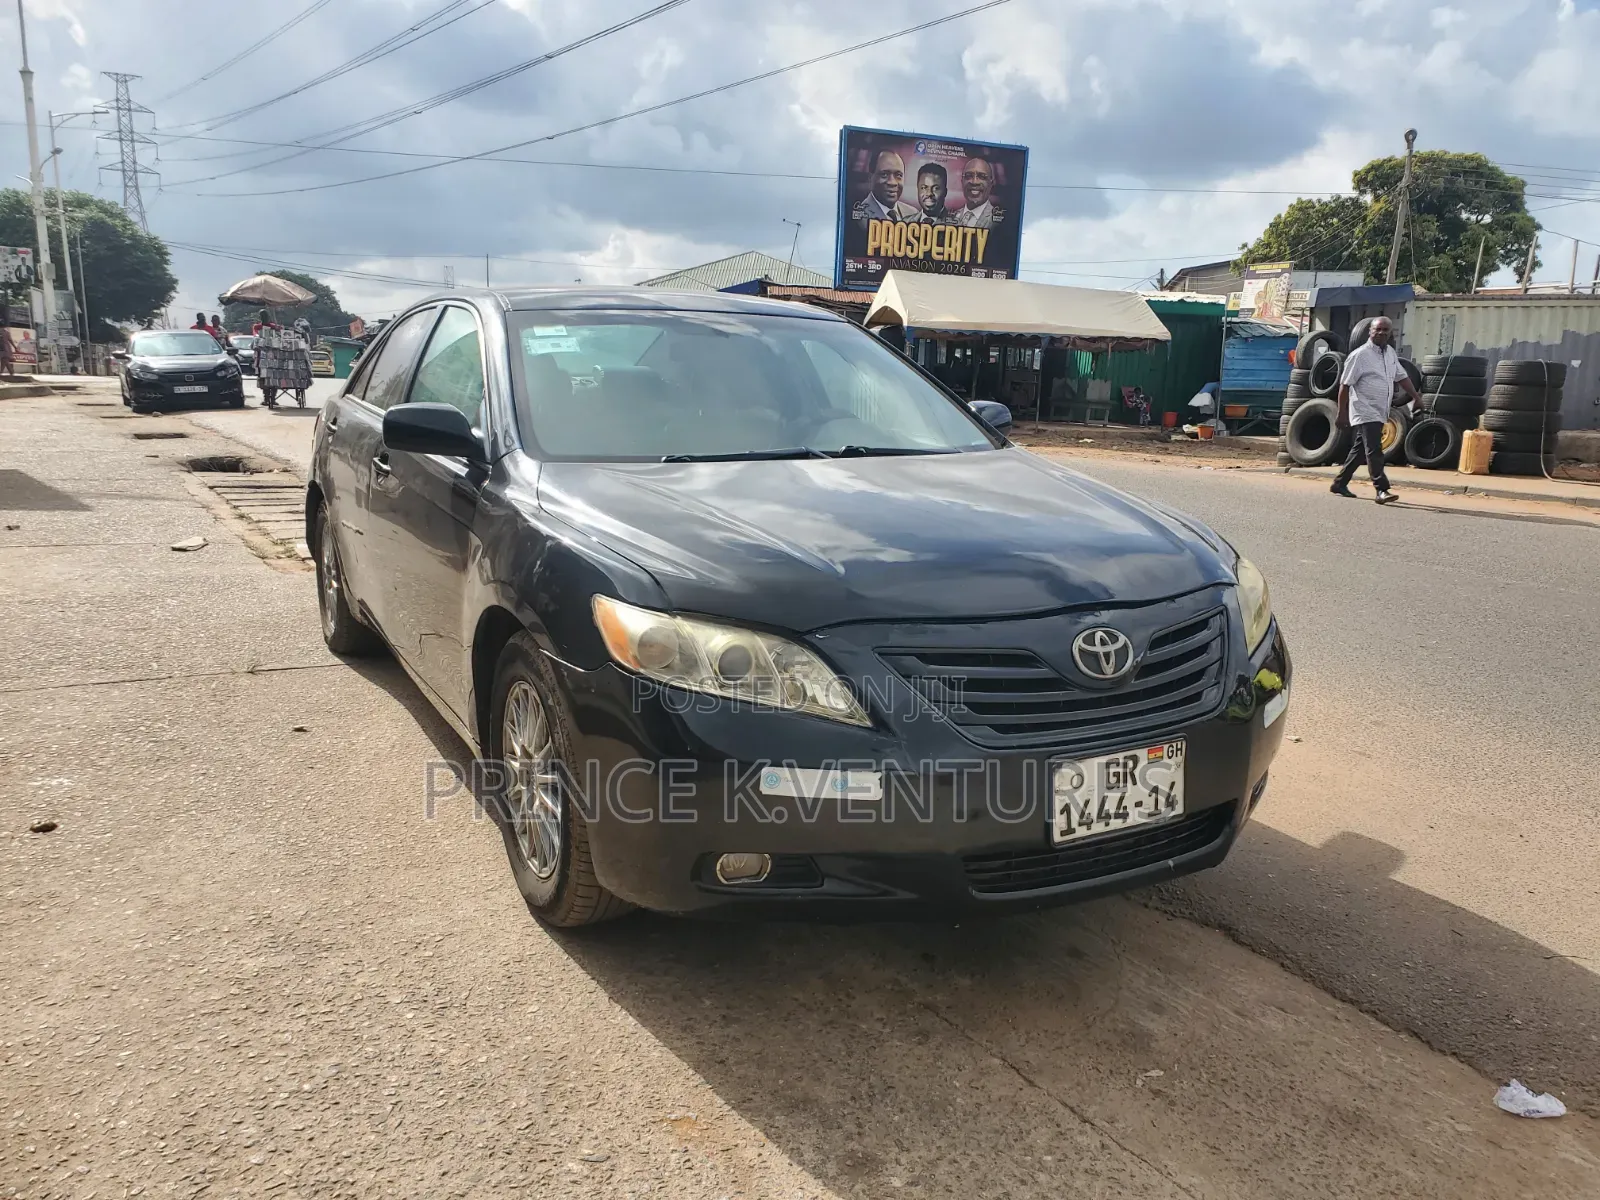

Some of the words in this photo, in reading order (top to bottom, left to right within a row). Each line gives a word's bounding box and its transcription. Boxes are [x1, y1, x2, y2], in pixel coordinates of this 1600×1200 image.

[867, 219, 990, 264] PROSPERITY
[845, 262, 863, 270] 26TH
[867, 263, 882, 271] 3RD
[889, 258, 936, 273] INVASION
[940, 262, 967, 274] 2026
[1166, 742, 1183, 760] GH
[1106, 754, 1140, 790] GR
[1060, 781, 1179, 837] 1444-14
